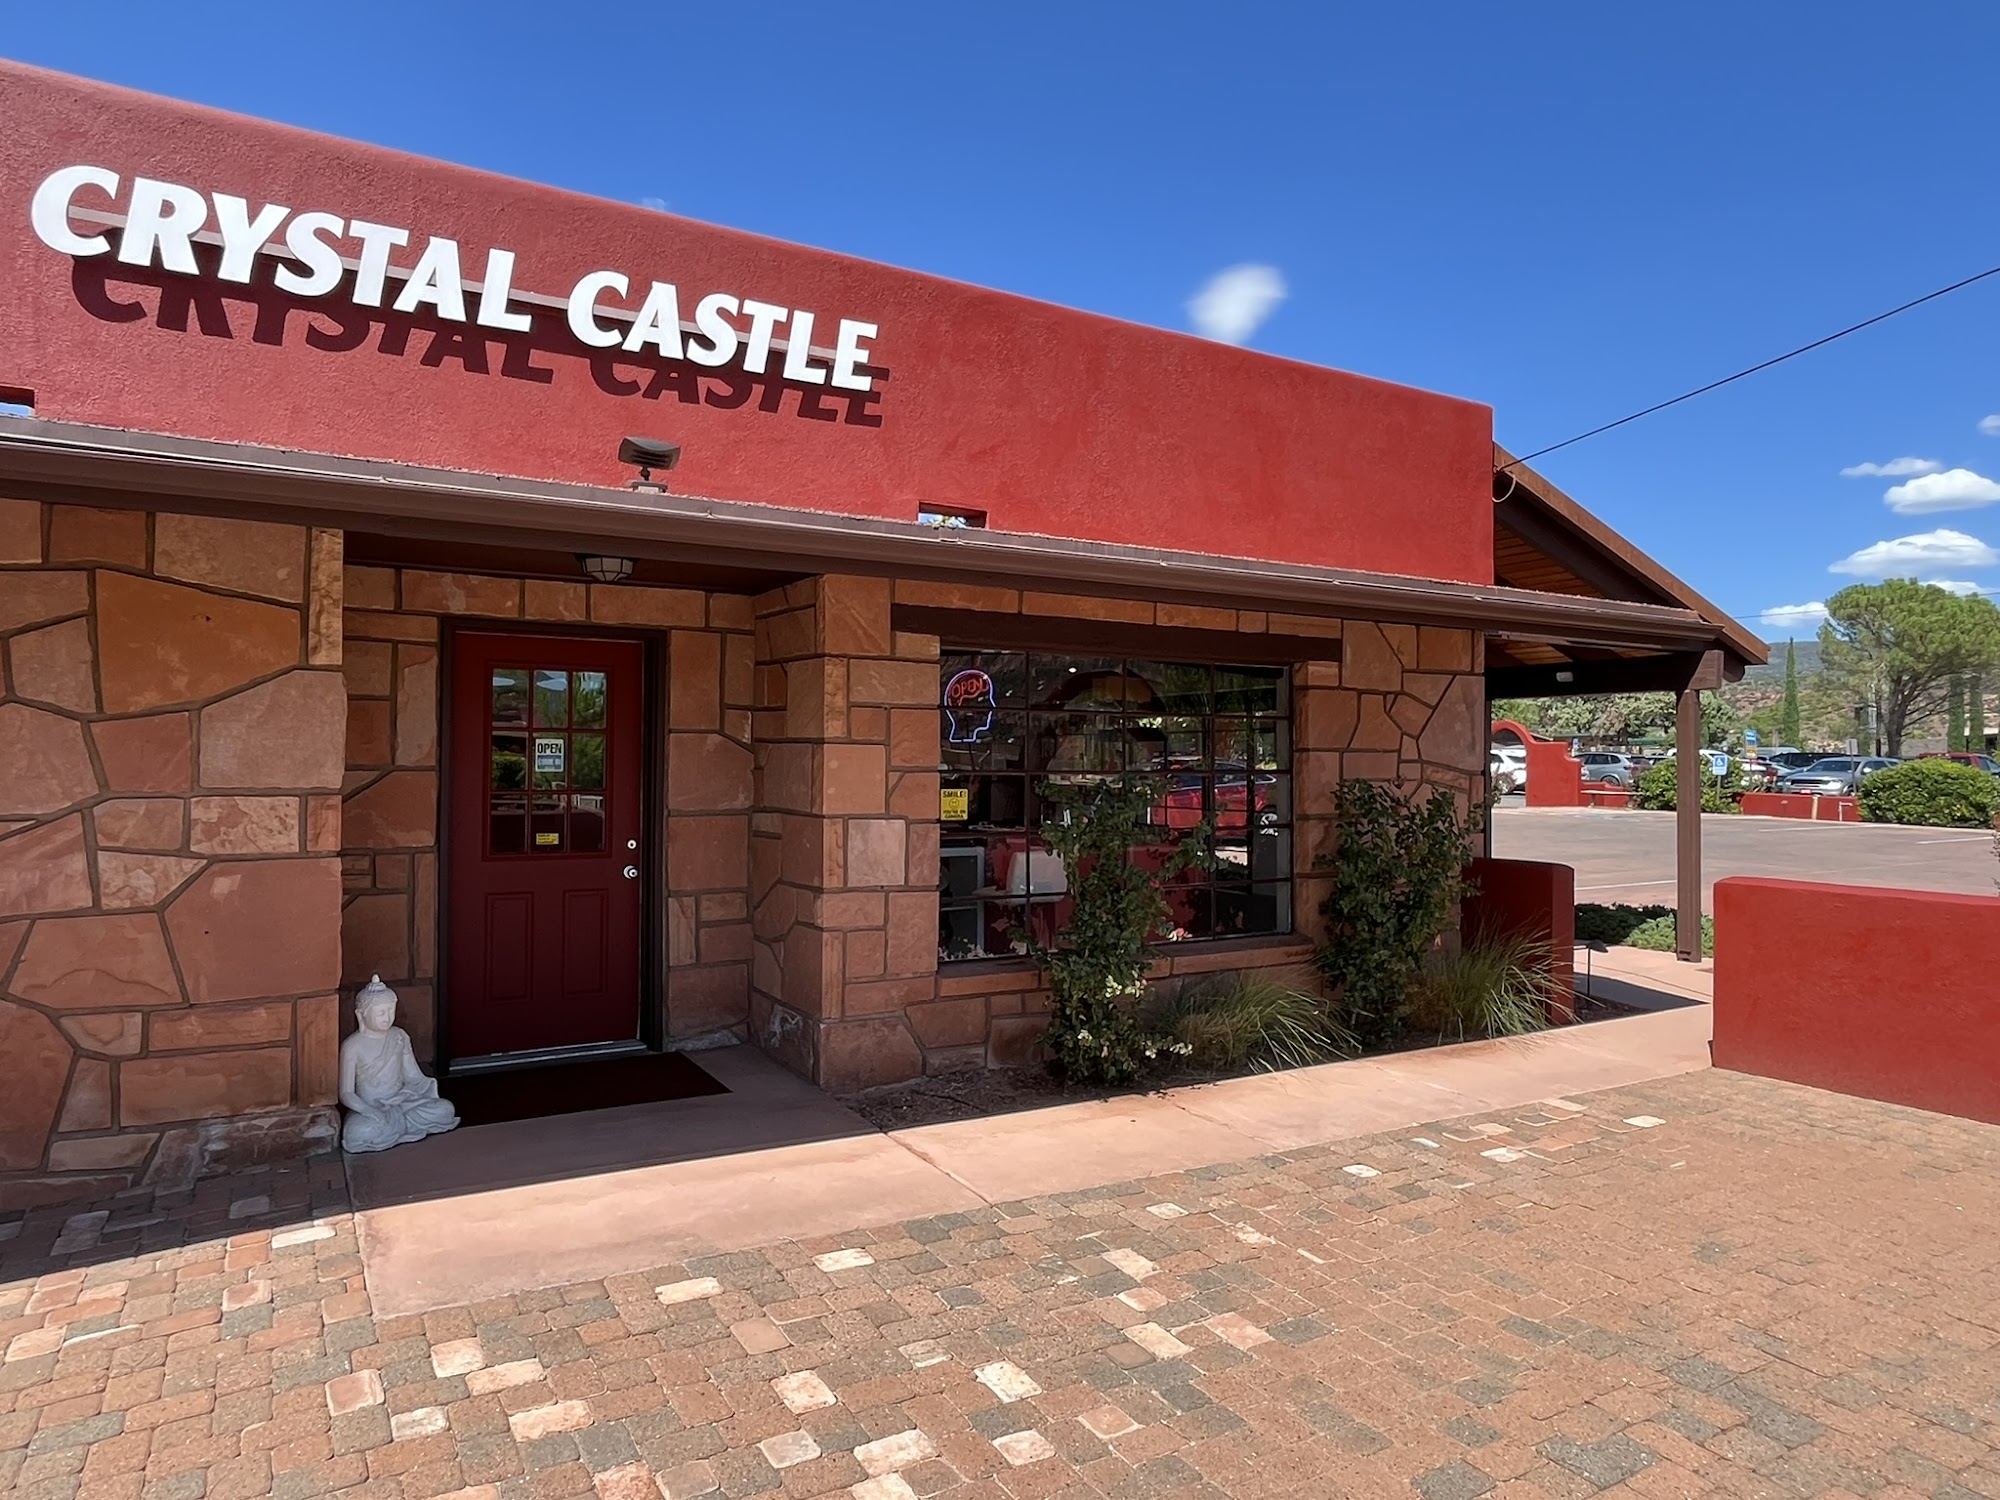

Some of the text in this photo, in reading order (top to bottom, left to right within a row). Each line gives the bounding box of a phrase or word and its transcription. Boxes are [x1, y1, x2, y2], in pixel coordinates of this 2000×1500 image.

[31, 165, 879, 392] CRYSTAL CASTLE
[951, 678, 983, 698] OPEN
[537, 743, 562, 754] OPEN
